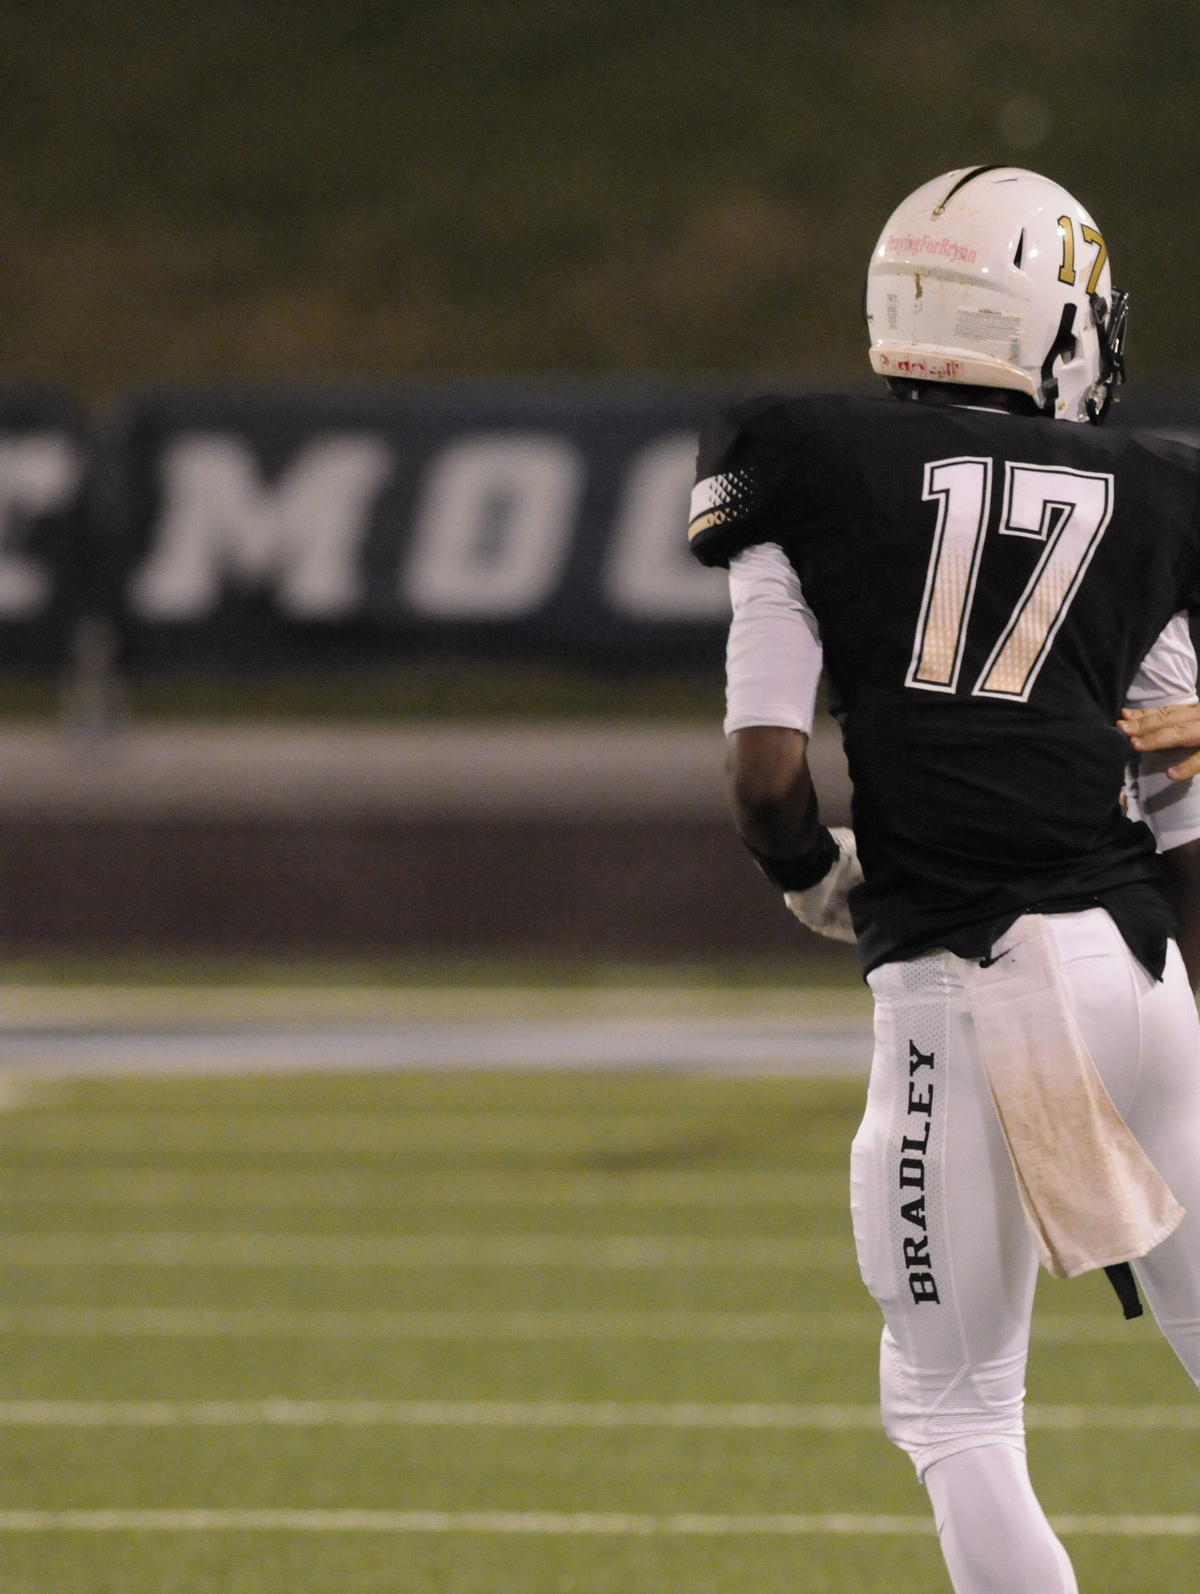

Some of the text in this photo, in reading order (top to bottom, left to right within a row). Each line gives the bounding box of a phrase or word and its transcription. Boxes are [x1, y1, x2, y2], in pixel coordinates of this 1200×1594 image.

[1057, 214, 1108, 296] 17
[903, 456, 1115, 703] 17
[900, 1038, 941, 1305] BRADLEY
